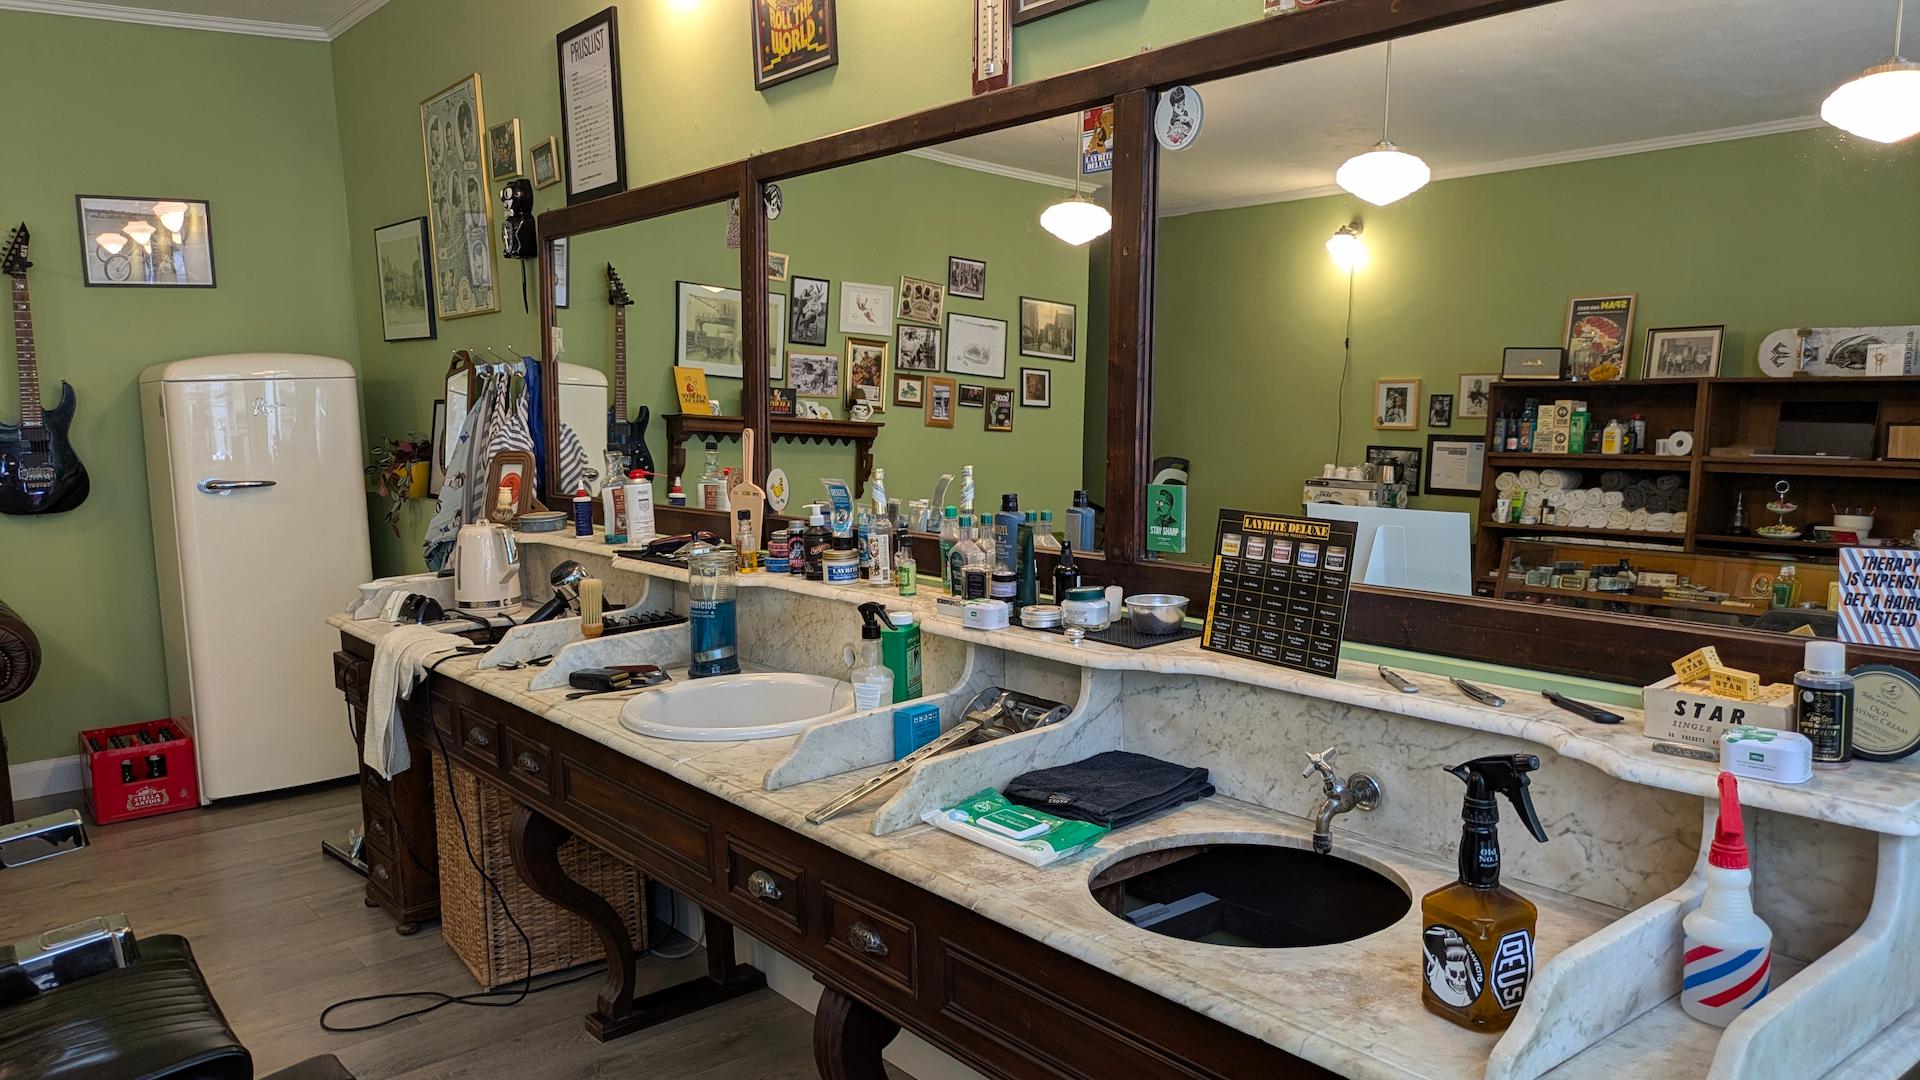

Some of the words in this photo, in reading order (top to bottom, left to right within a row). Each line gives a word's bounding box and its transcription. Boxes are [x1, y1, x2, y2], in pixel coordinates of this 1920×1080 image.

[770, 6, 792, 30] ROLL
[793, 0, 814, 26] THE
[771, 18, 816, 56] WORLD
[1150, 526, 1162, 535] STAY
[1162, 526, 1180, 537] SHARP
[1244, 518, 1287, 532] LAYRITE
[1288, 522, 1329, 537] DELUXE
[1861, 556, 1920, 572] THERAPY
[1846, 571, 1860, 586] IS
[1863, 572, 1920, 590] EXPENSI
[1843, 592, 1869, 607] GET
[1870, 593, 1881, 608] A
[1884, 594, 1920, 611] HAIRC
[1861, 609, 1918, 628] INSTEAD
[1681, 659, 1704, 674] STAR
[1715, 680, 1742, 692] STAR
[1674, 699, 1746, 725] STAR
[1869, 704, 1889, 718] OUD
[1672, 719, 1713, 733] SINGLE
[1856, 706, 1878, 722] AVING
[1880, 717, 1908, 736] CREAM
[134, 793, 161, 802] STELLA
[134, 798, 161, 808] ARTOIS
[1479, 854, 1498, 863] No.1
[1480, 847, 1497, 856] Old
[1465, 944, 1483, 983] SUAVECITO
[1496, 939, 1526, 1001] DEUS
